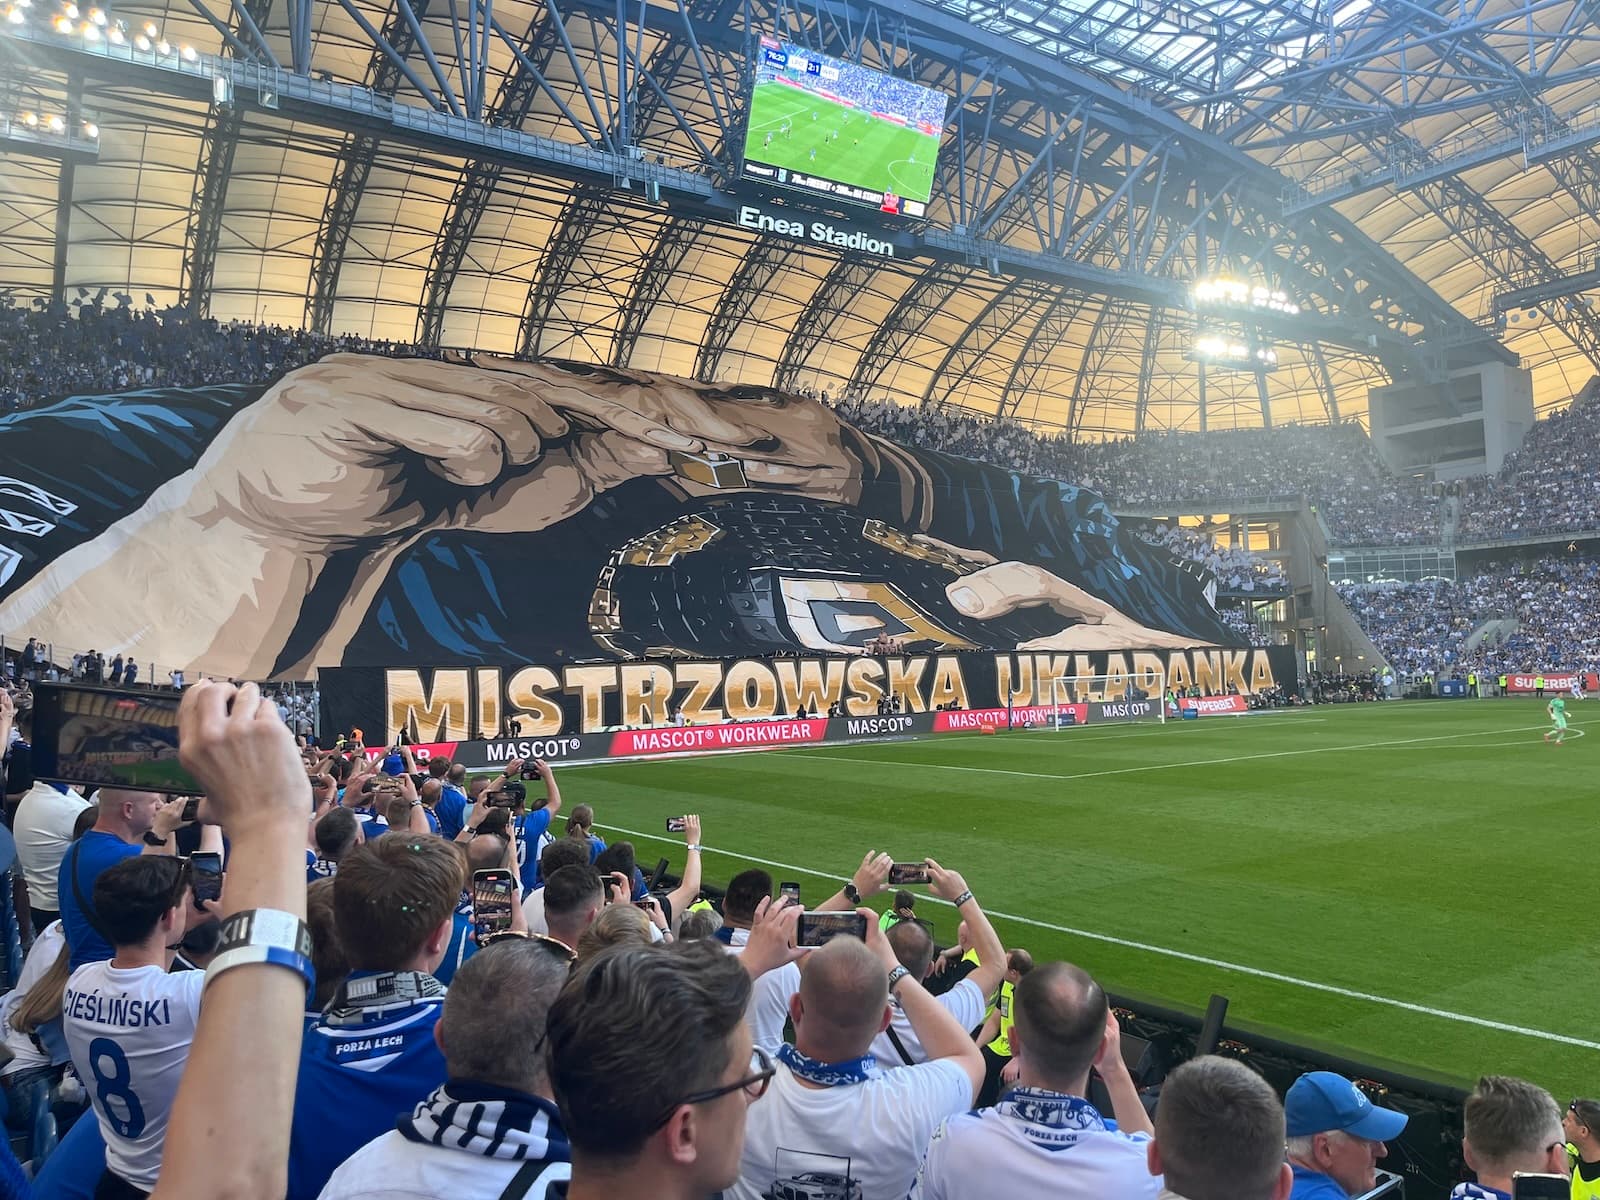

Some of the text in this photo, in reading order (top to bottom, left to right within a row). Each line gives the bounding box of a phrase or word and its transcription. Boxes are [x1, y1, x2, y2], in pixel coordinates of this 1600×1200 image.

[739, 205, 894, 256] Enea Stadion
[384, 650, 1275, 747] MISTRZOWSKA UKŁADANKA
[1187, 697, 1237, 711] SUPERBET
[719, 723, 811, 743] WORKWEAR
[64, 988, 170, 1027] CIEŚLIŃSKI
[335, 1035, 404, 1055] FORZA LECH
[89, 1037, 146, 1138] 8
[1024, 1127, 1078, 1142] FORZA LECH
